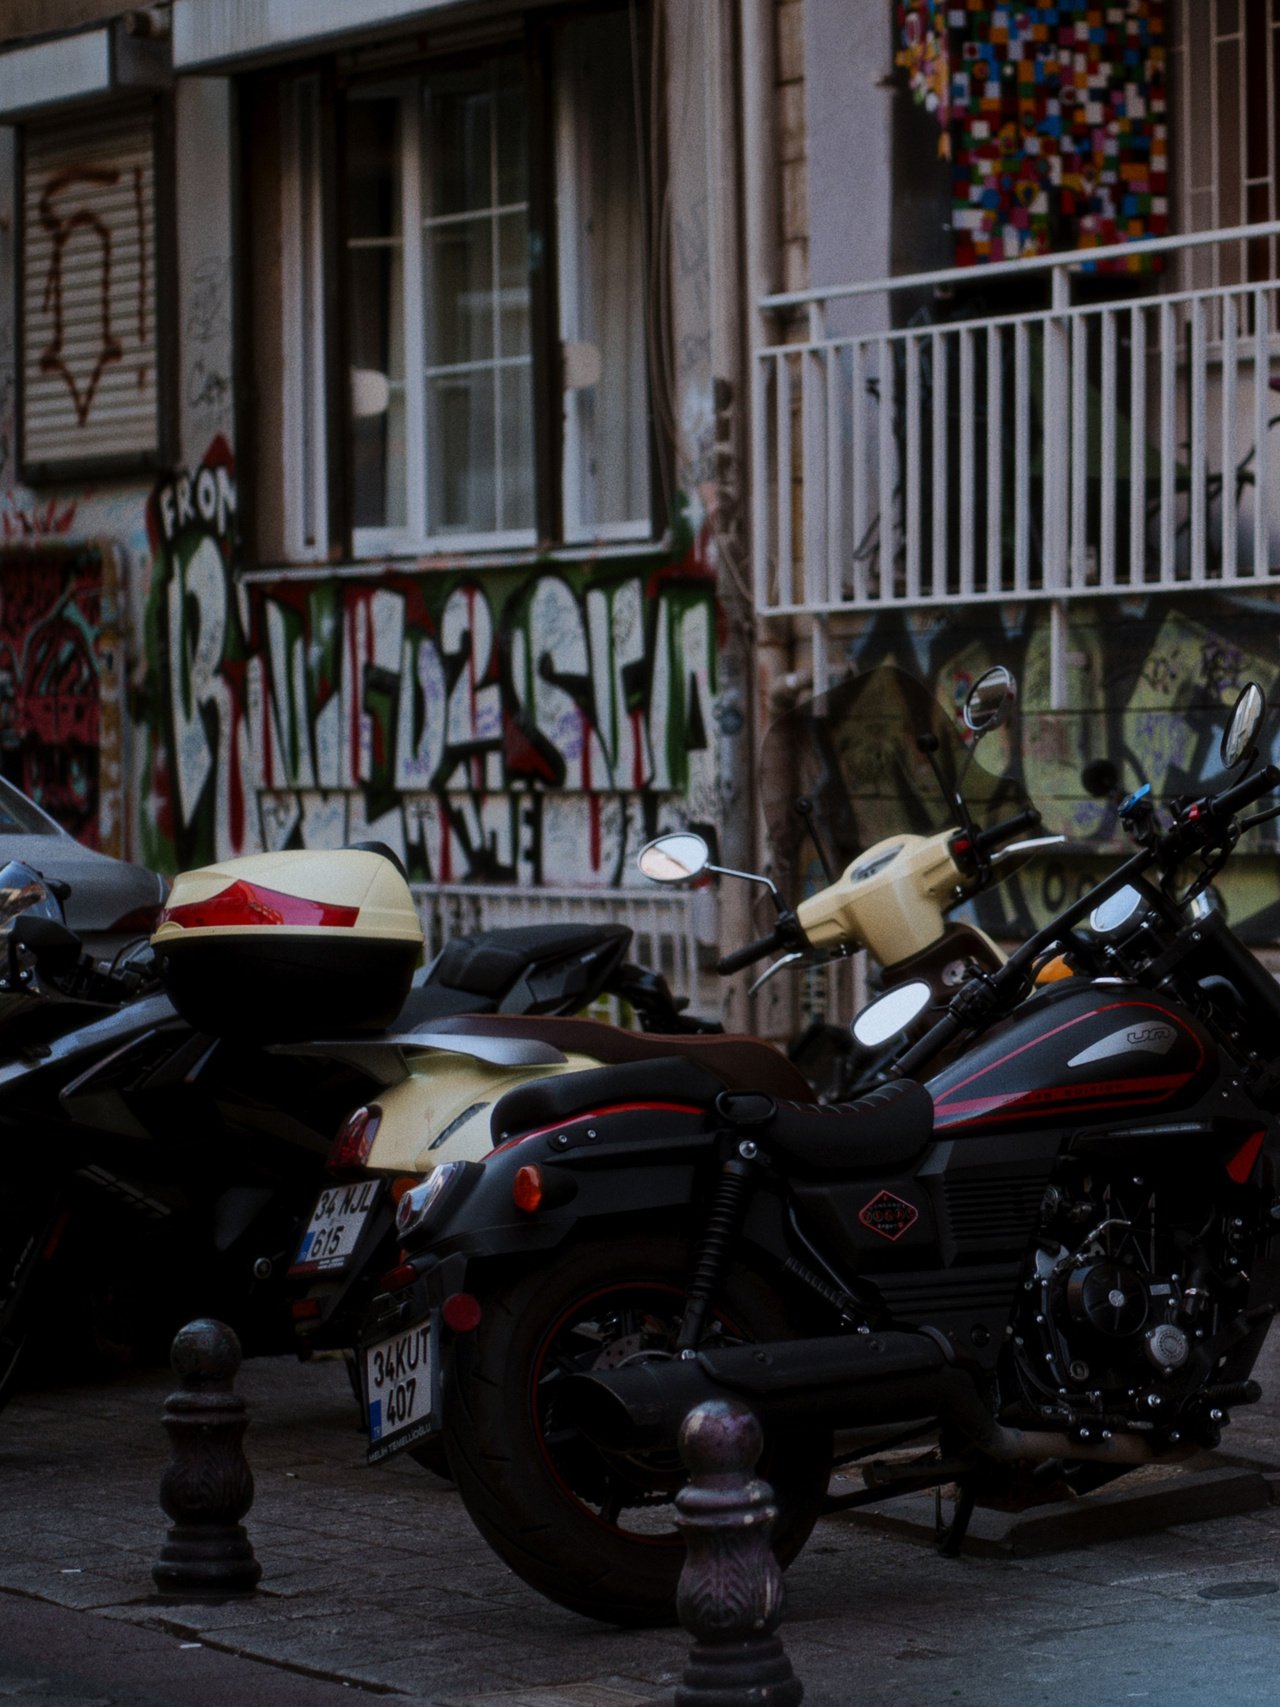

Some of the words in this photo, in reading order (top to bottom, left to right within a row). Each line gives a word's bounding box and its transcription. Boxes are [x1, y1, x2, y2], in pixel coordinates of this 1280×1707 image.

[314, 1190, 338, 1221] 34
[339, 1183, 372, 1217] NJL
[311, 1225, 345, 1258] 615
[386, 1377, 417, 1427] 407
